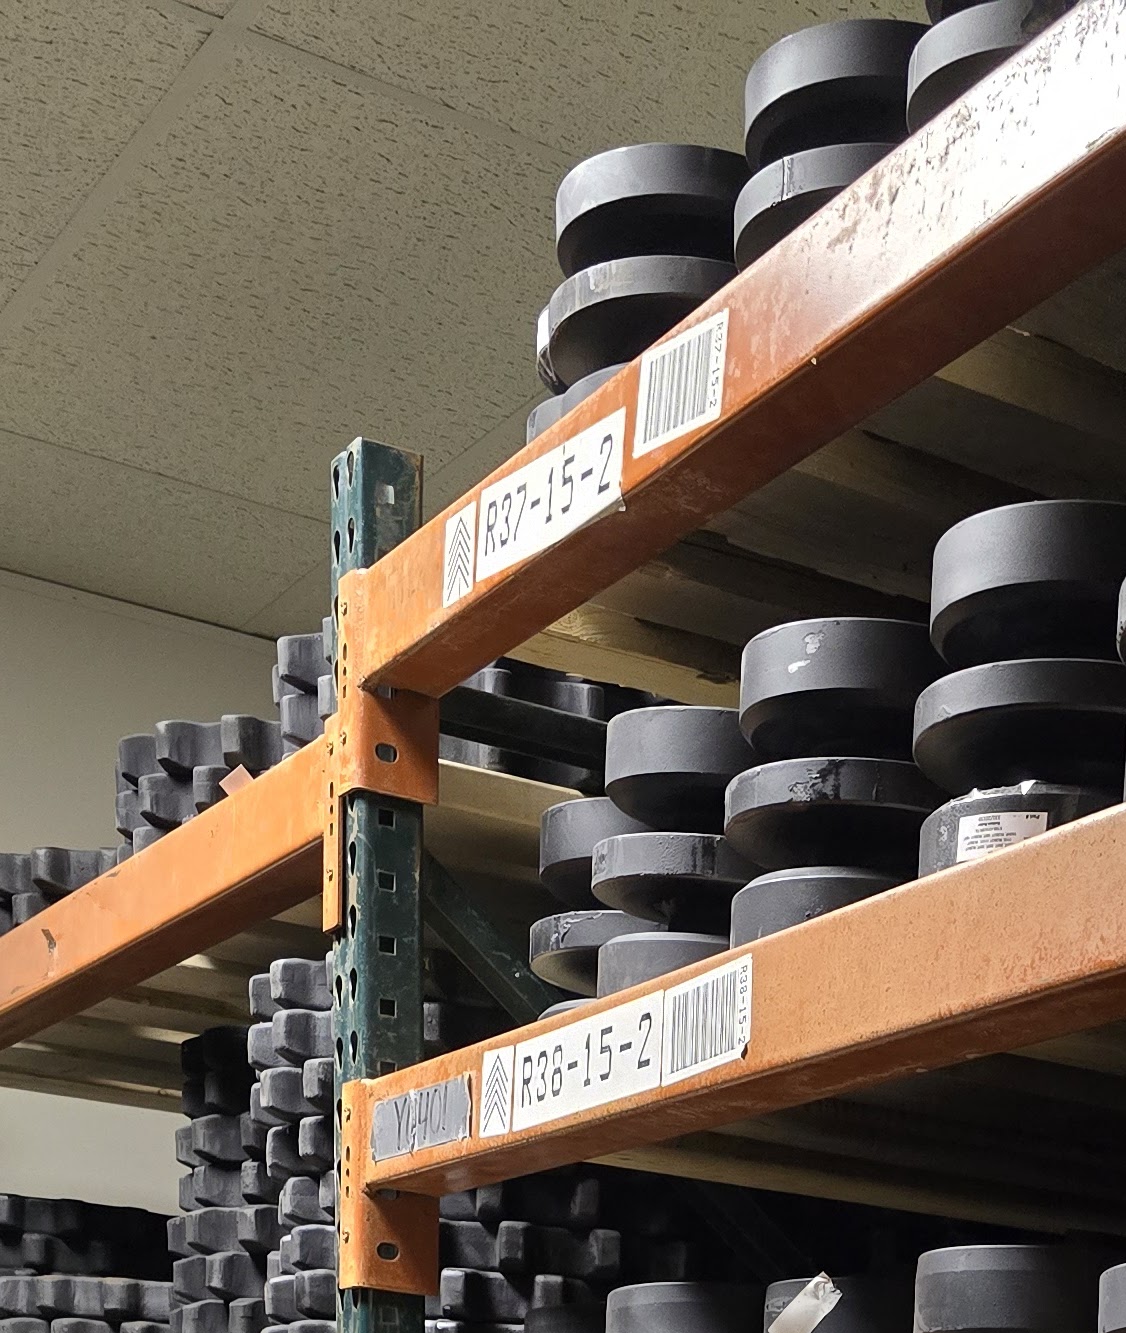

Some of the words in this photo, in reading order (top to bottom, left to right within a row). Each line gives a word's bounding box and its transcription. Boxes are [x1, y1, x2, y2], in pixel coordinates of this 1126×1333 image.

[709, 321, 724, 408] R37-15-2
[484, 433, 613, 556] R37-15-2
[737, 964, 749, 1045] R38-15-2
[520, 1012, 653, 1109] R38-15-2
